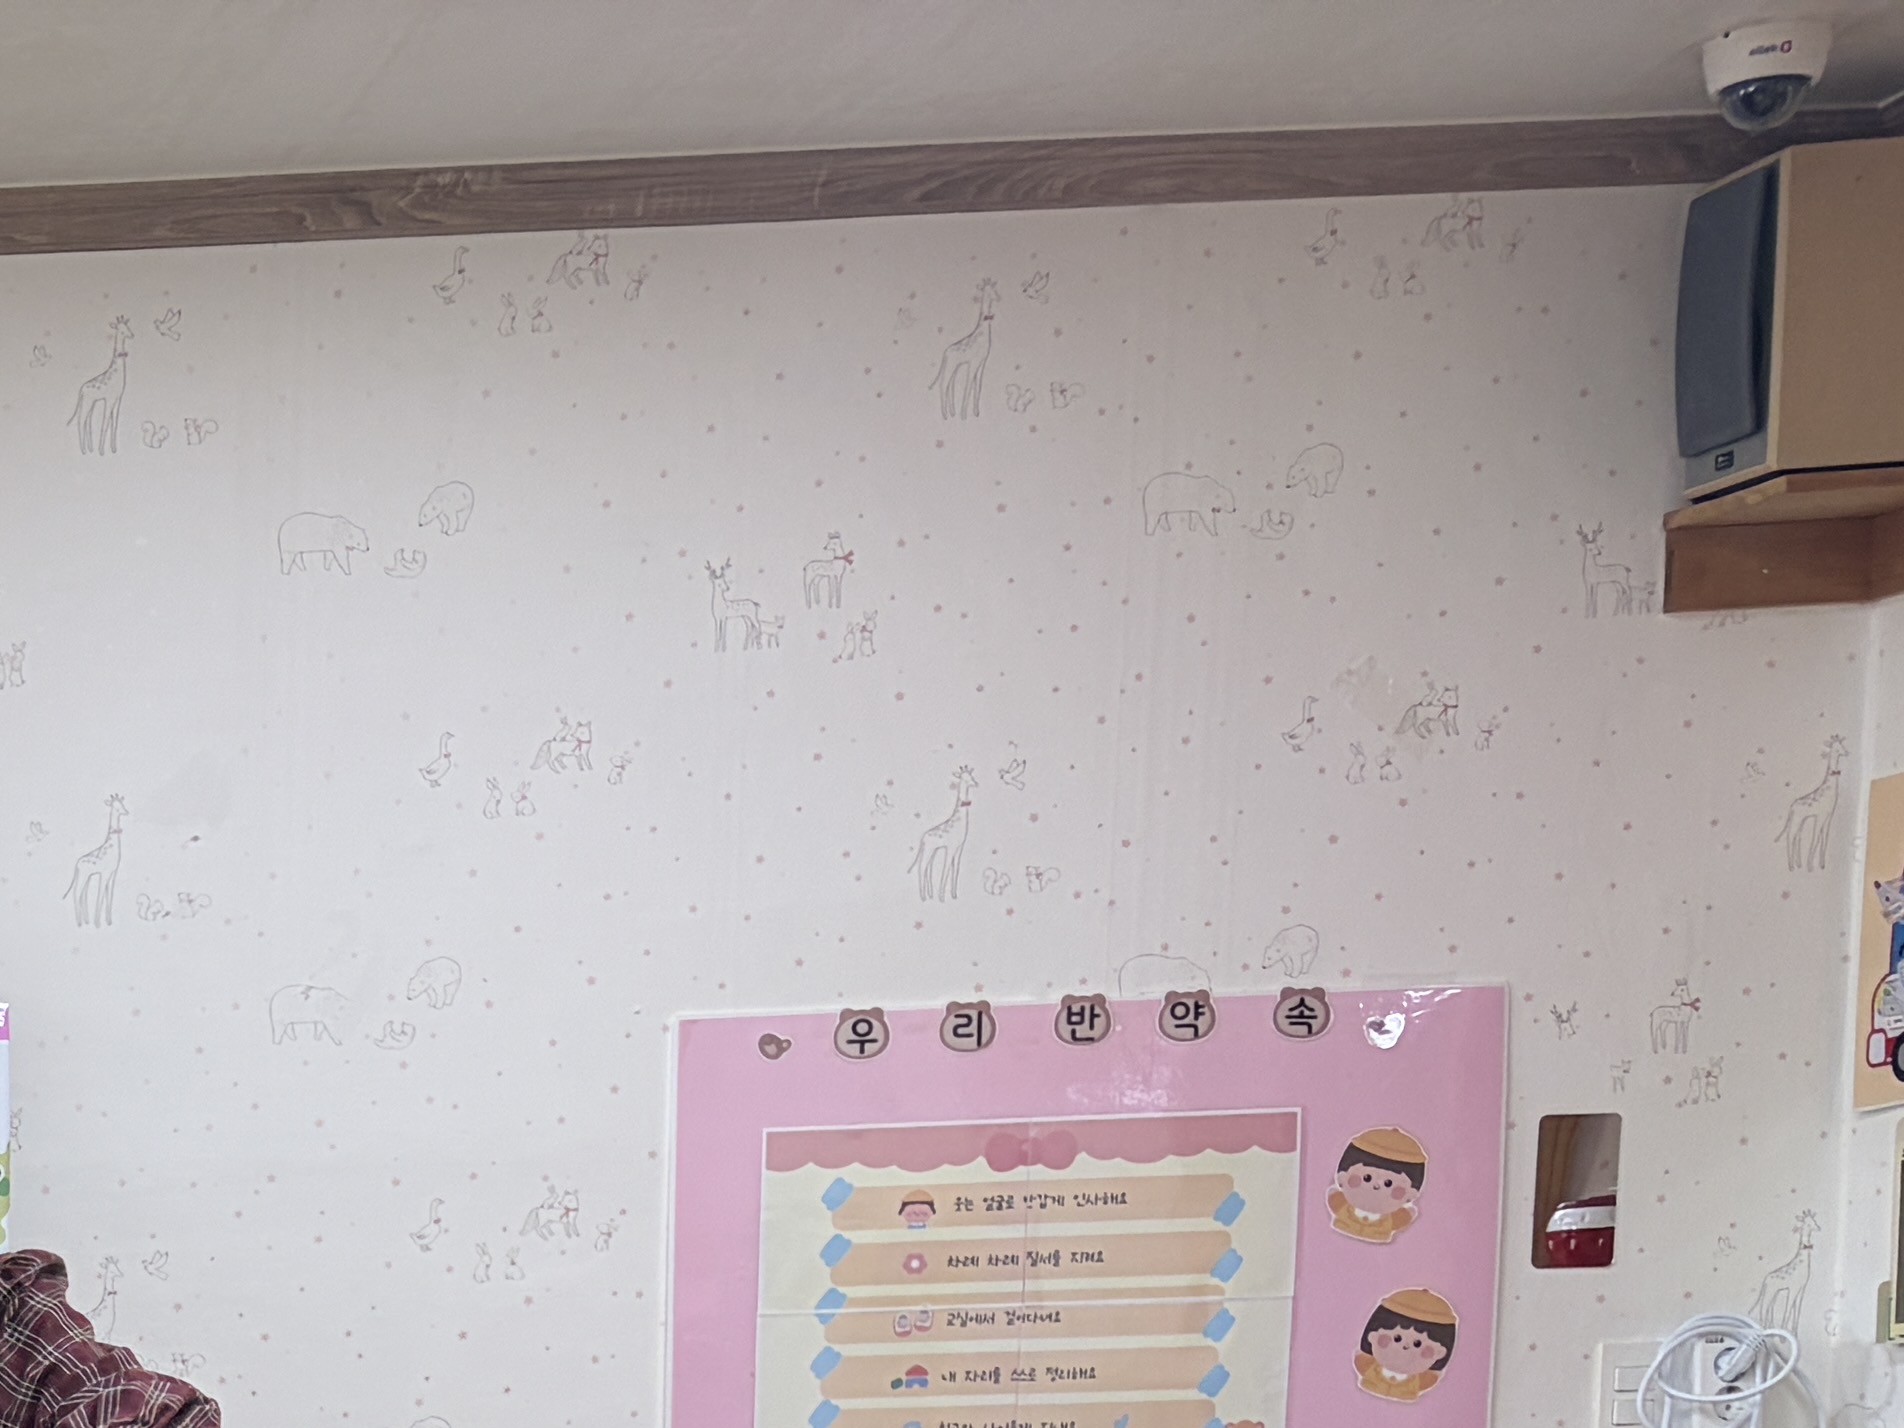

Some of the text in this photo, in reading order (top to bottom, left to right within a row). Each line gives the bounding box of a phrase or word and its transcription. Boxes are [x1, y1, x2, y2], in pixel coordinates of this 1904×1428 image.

[982, 1195, 1015, 1211] 얼굴로
[1073, 1191, 1129, 1207] 인사해요
[947, 1254, 980, 1268] 차례
[987, 1253, 1020, 1267] 차례
[1026, 1249, 1061, 1267] 질서를
[946, 1311, 996, 1327] 교실에서
[941, 1371, 957, 1383] 내
[964, 1366, 1001, 1384] 자리를
[1045, 1366, 1097, 1382] 정리해요
